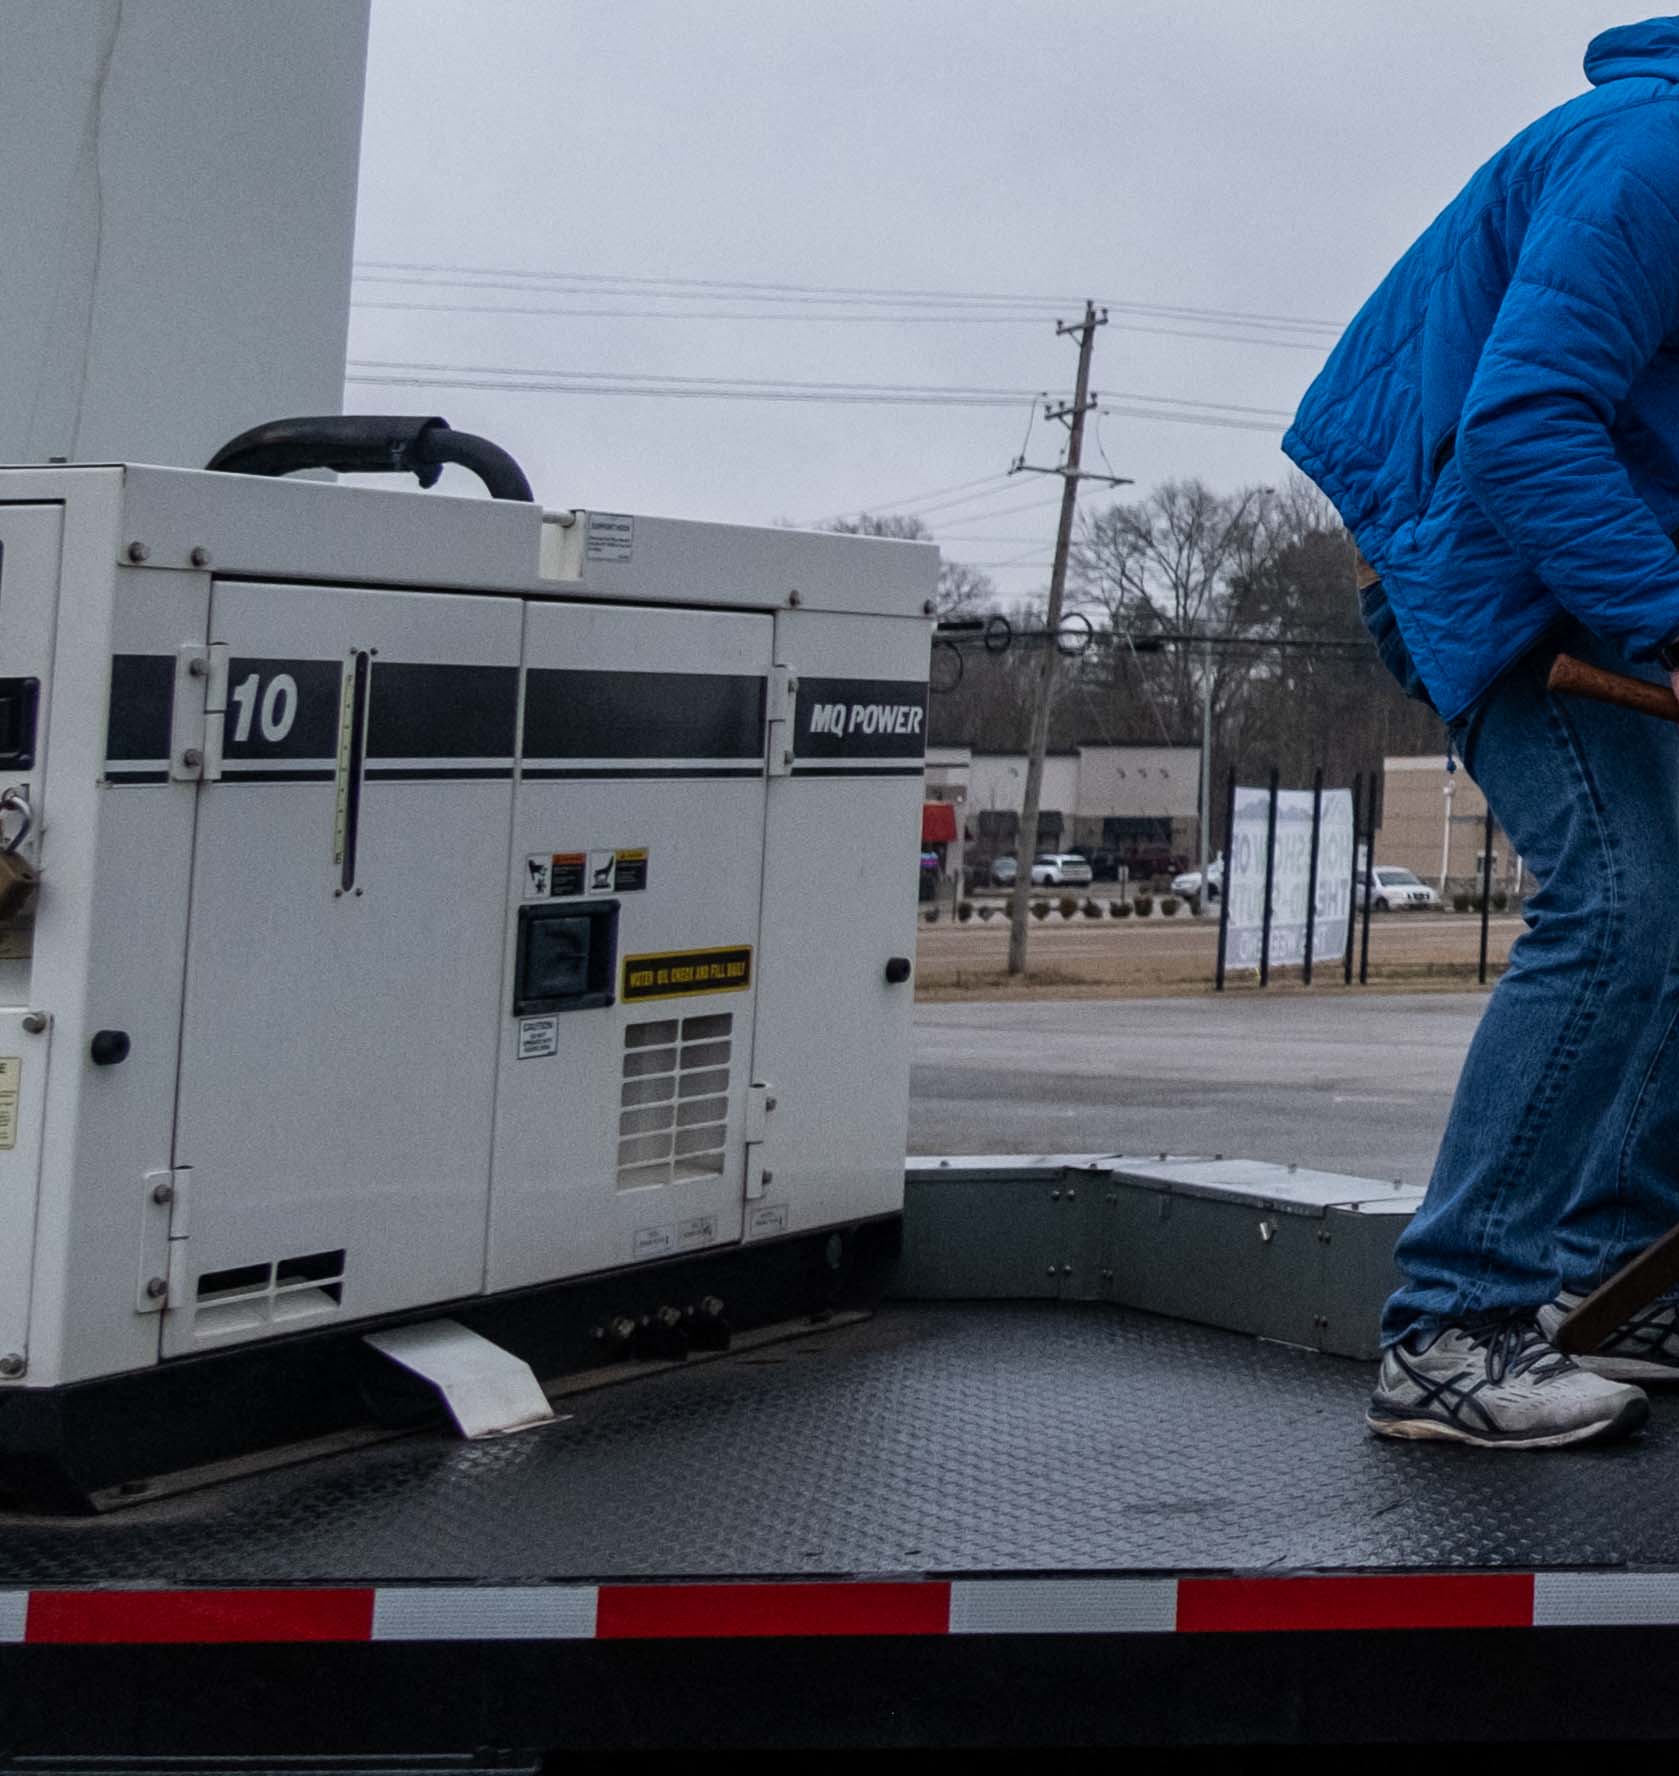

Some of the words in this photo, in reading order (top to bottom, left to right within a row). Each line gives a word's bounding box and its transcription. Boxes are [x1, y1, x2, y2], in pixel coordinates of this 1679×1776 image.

[232, 673, 298, 742] 10
[810, 704, 847, 738] MQ
[848, 704, 924, 734] POWER
